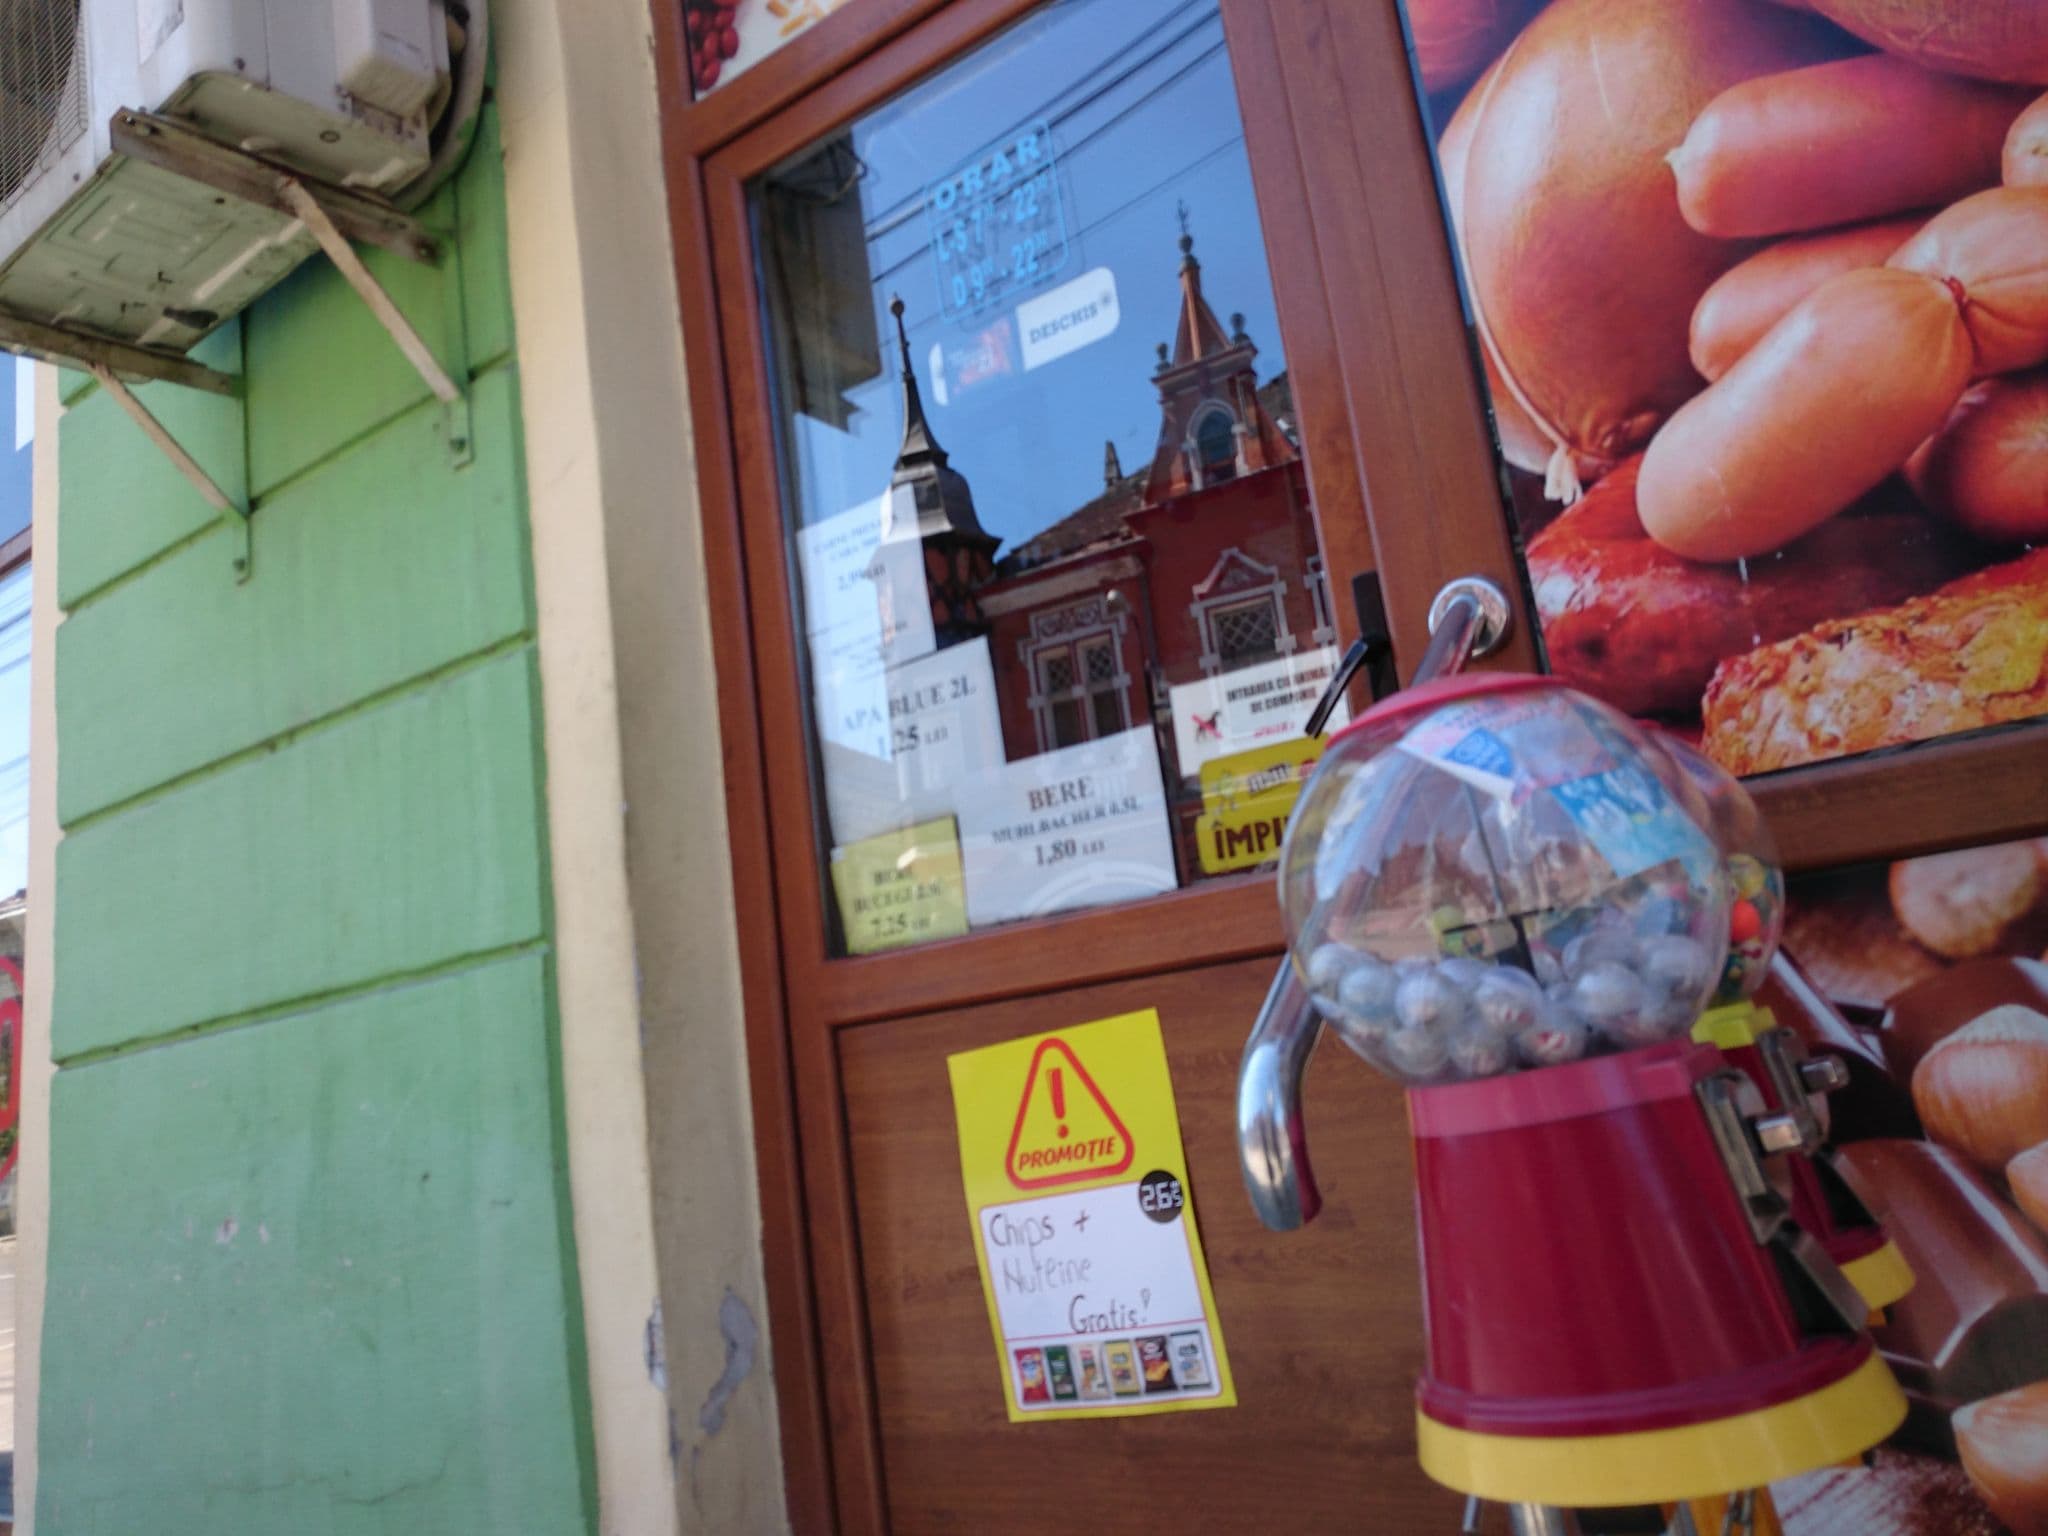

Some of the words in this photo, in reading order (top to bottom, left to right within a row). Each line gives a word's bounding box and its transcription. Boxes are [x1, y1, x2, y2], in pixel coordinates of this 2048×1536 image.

[934, 133, 1042, 210] ORAR
[1029, 301, 1099, 344] DESCHIS
[889, 682, 947, 719] BLUE
[1028, 775, 1096, 813] BERE
[1018, 1135, 1118, 1172] PROMOȚIE
[990, 1213, 1055, 1268] Chips
